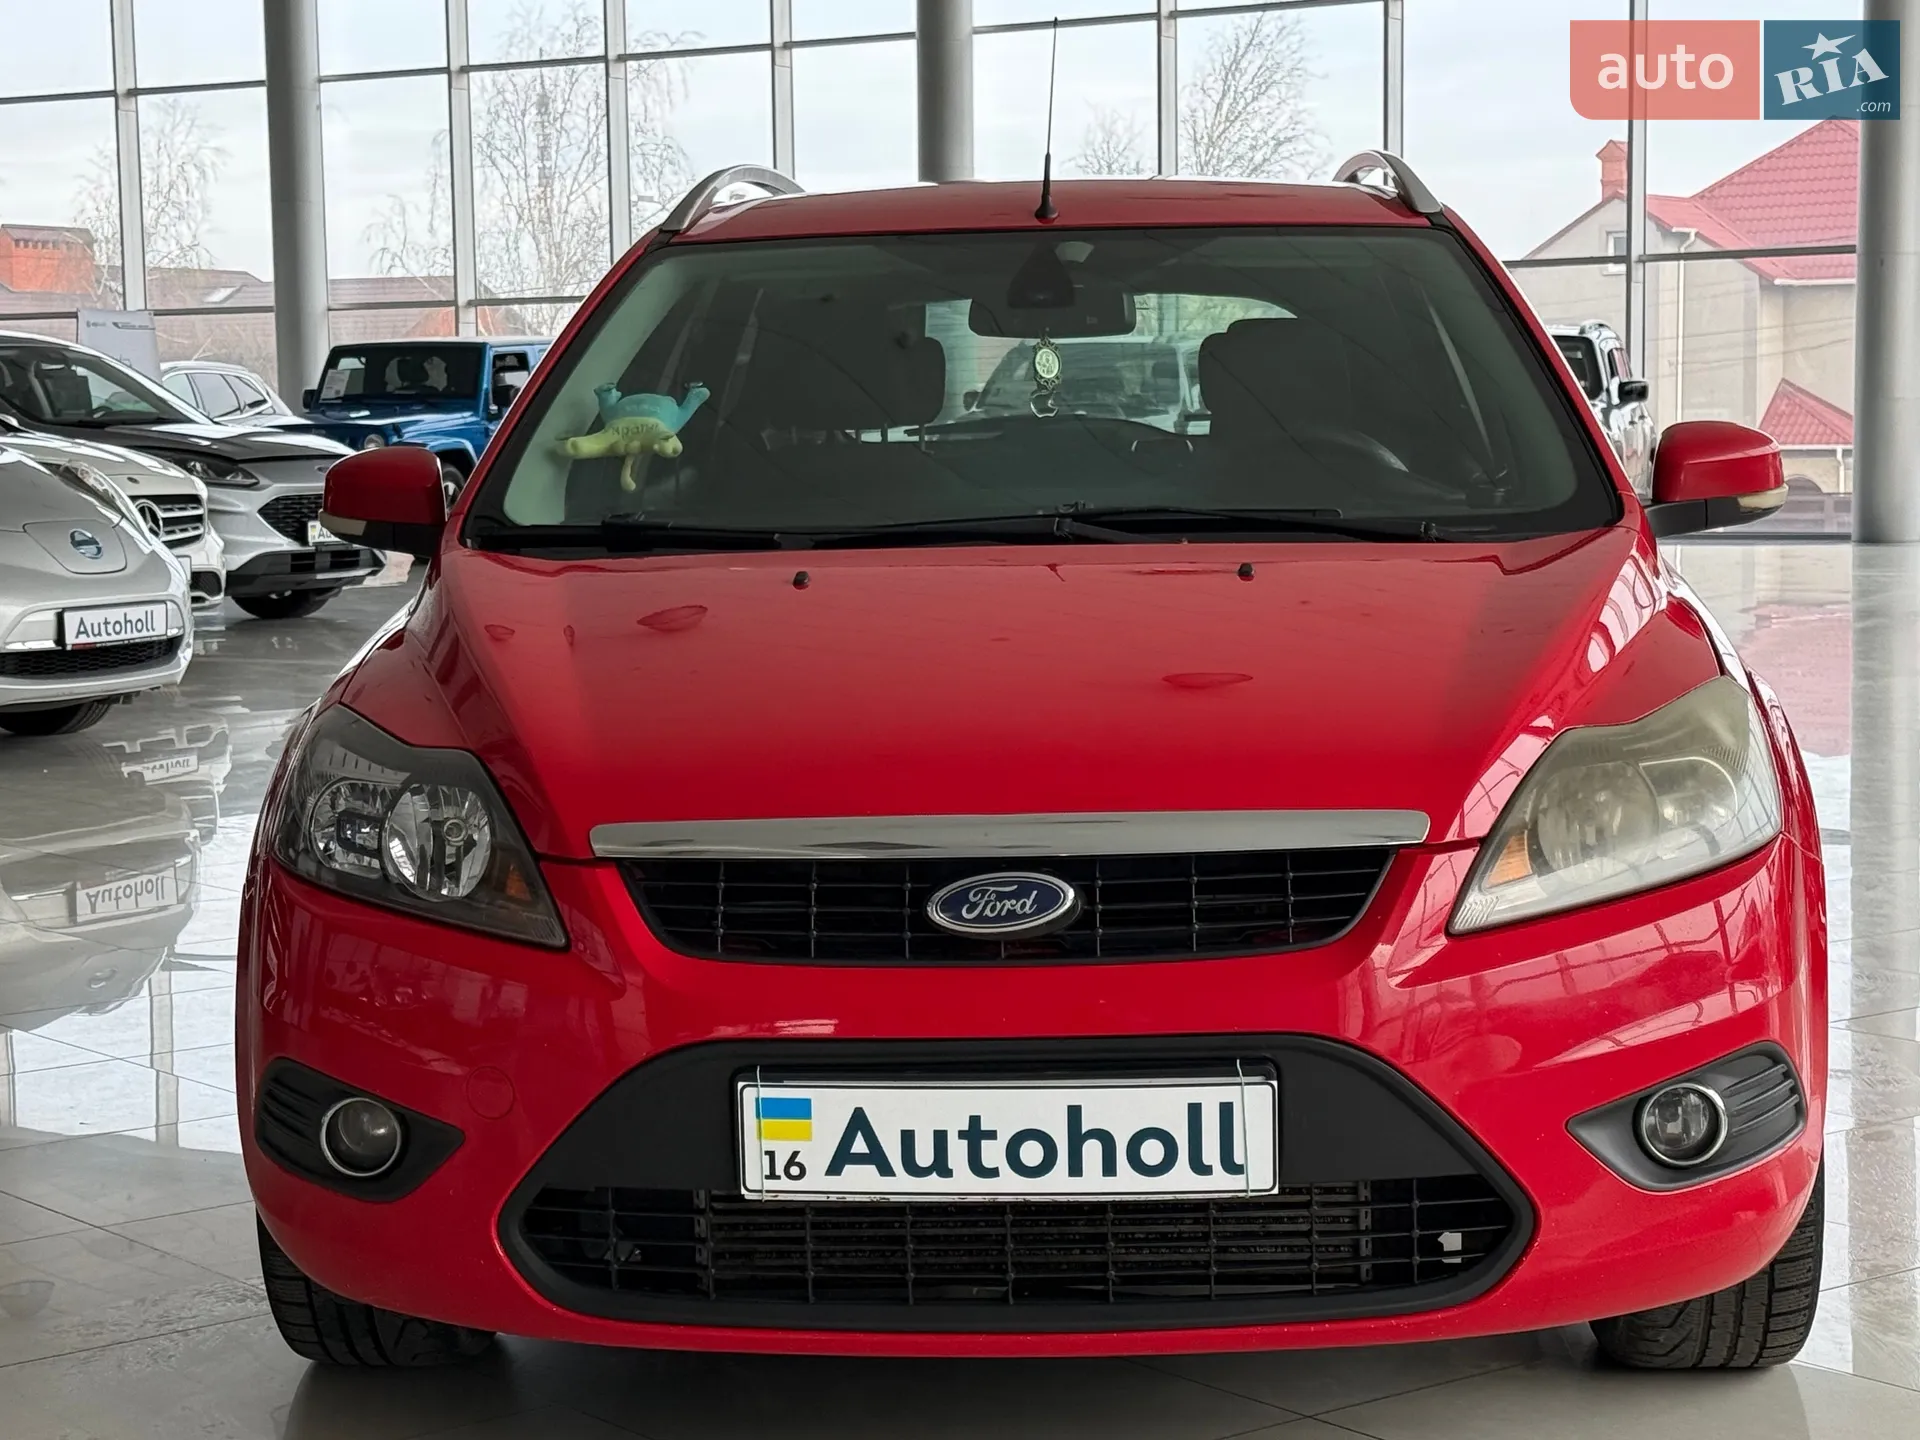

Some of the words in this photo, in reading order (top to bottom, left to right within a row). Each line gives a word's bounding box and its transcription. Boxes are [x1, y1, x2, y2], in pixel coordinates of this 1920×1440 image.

[75, 610, 155, 639] Autoholl
[961, 885, 1038, 919] Ford
[824, 1101, 1247, 1180] Autoholl
[763, 1150, 807, 1182] 16
